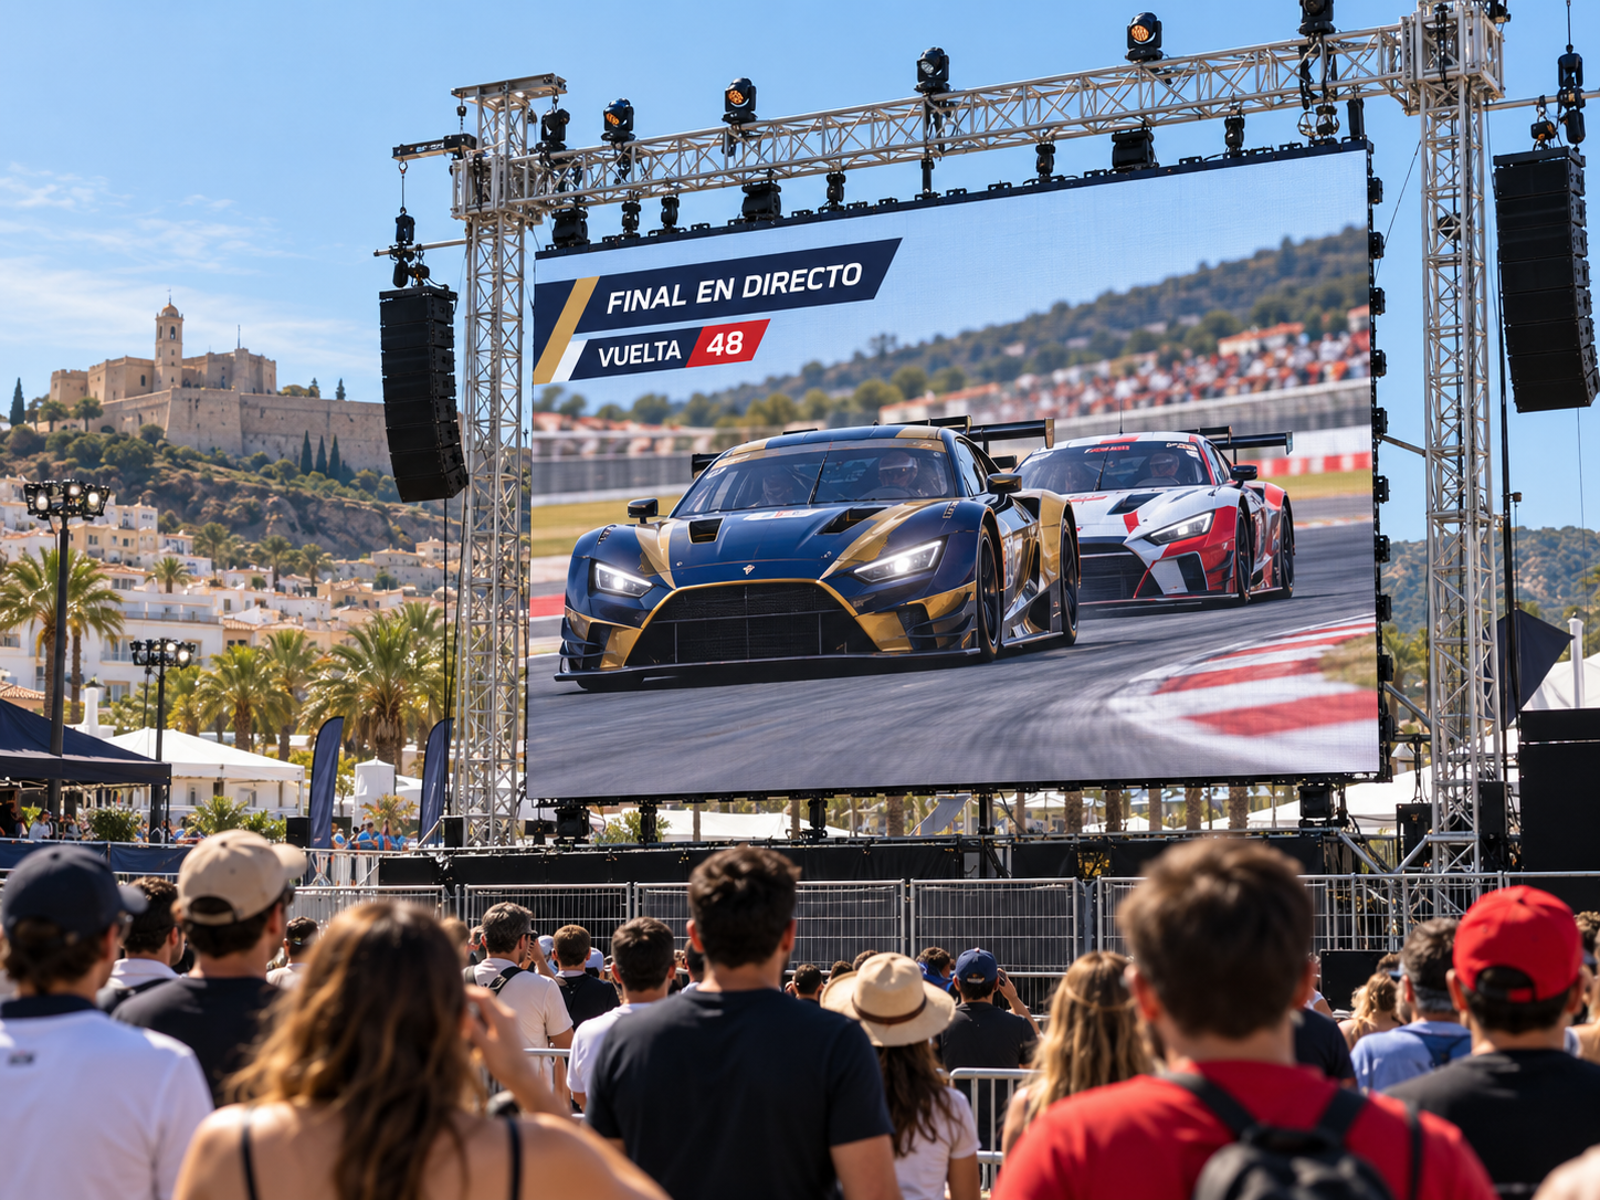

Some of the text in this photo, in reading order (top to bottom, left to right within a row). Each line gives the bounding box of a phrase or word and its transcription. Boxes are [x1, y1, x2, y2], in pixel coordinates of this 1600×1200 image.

[606, 262, 863, 314] FINAL EN DIRECTO
[598, 331, 744, 367] VUELTA 48
